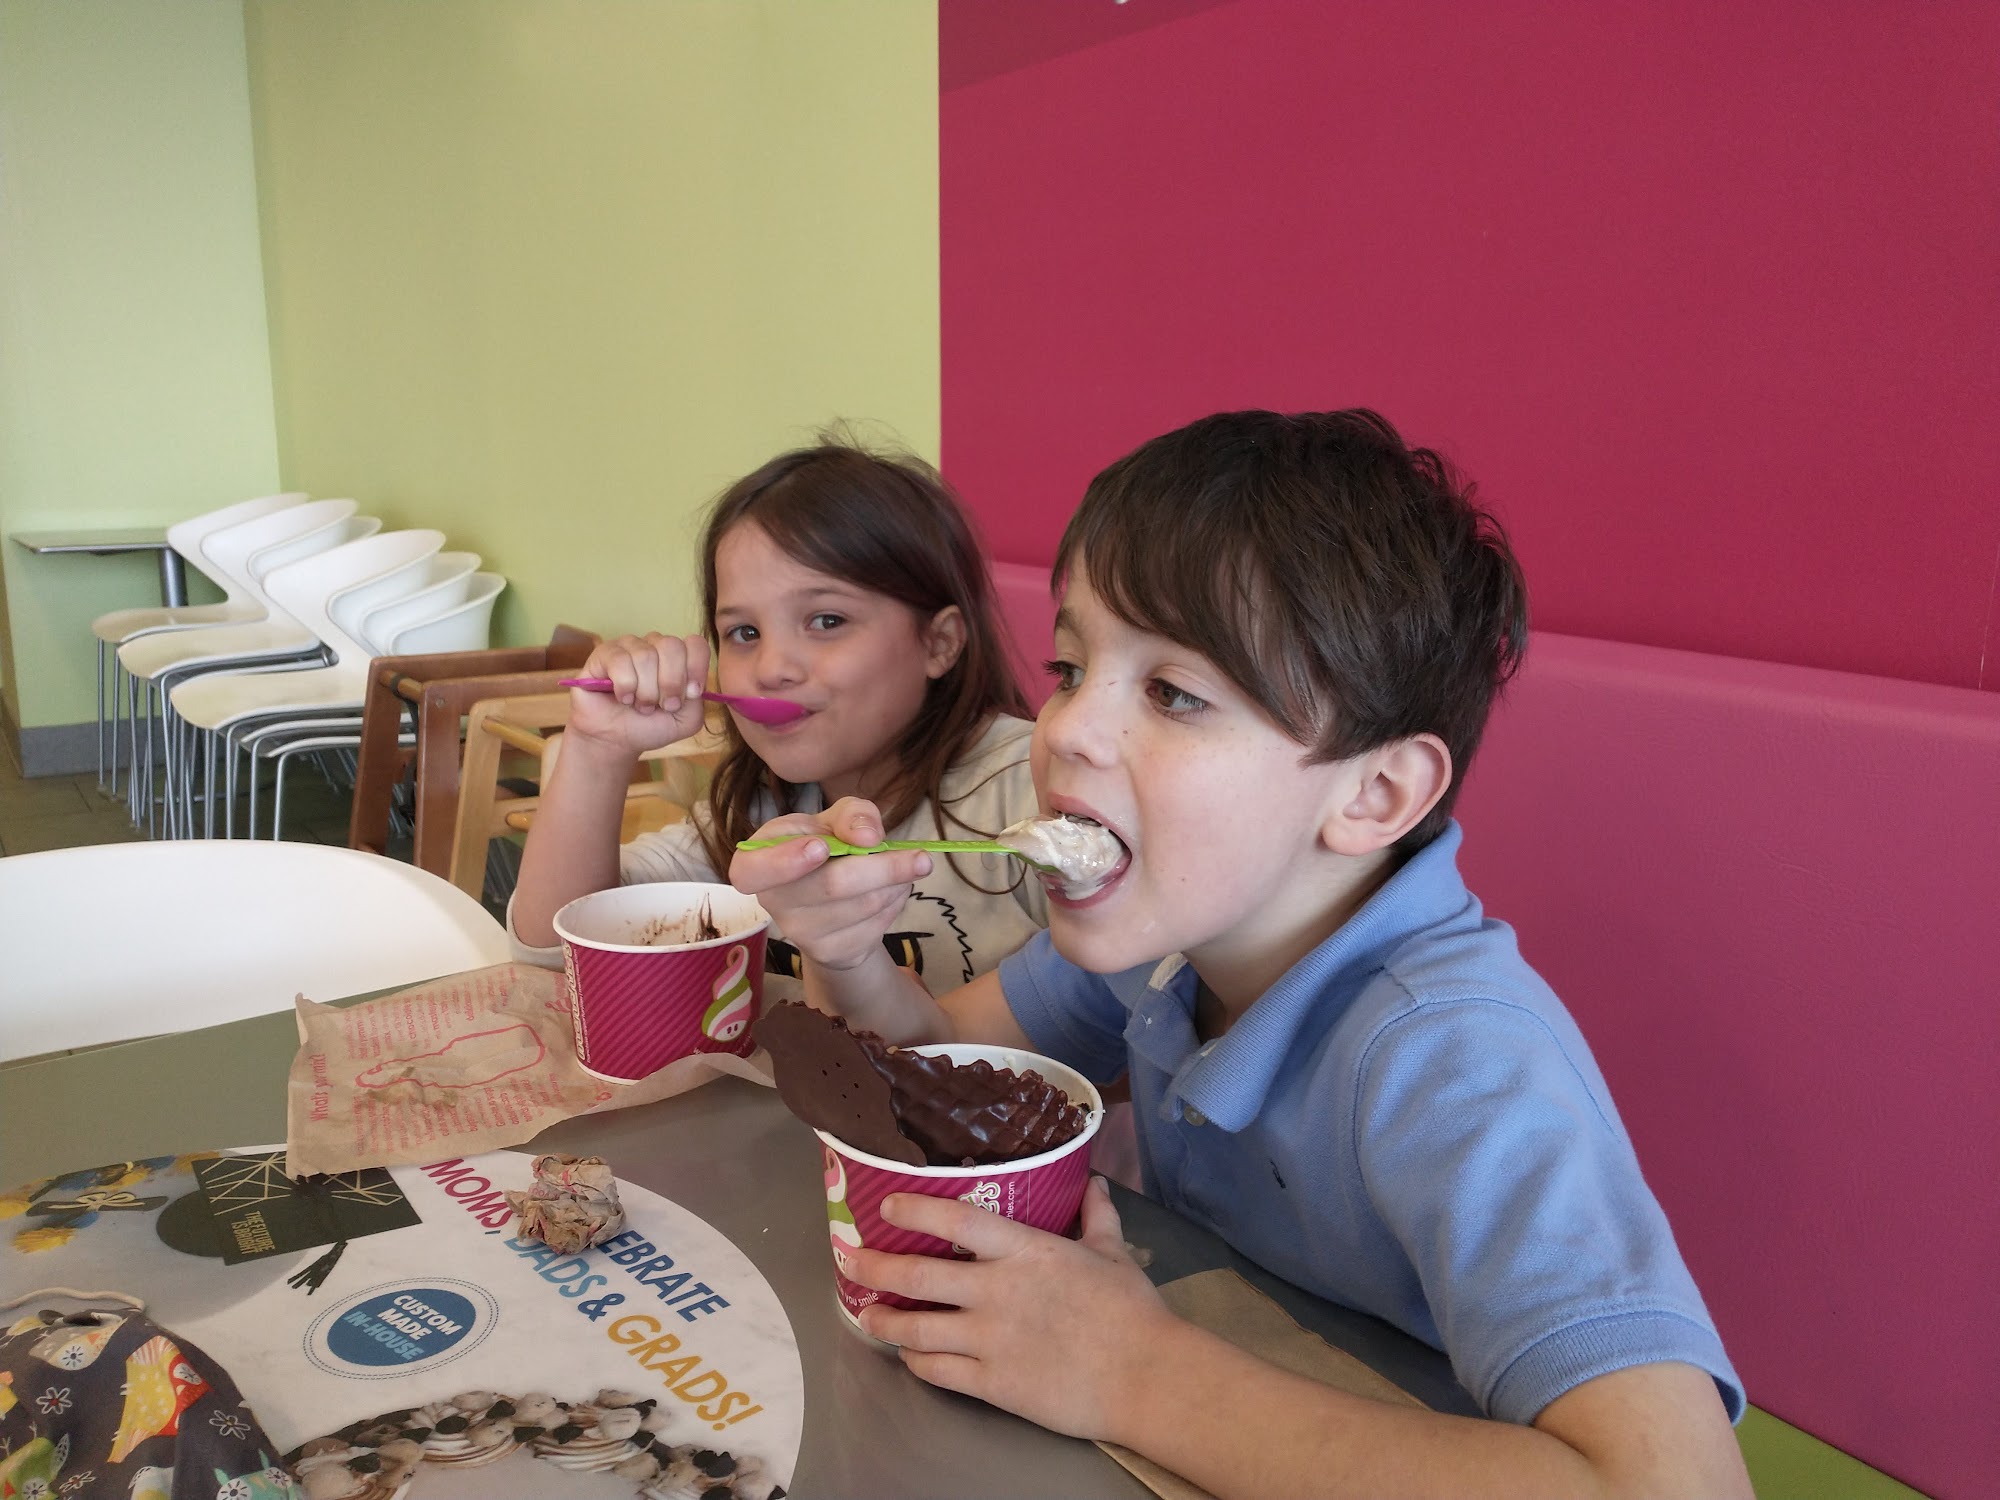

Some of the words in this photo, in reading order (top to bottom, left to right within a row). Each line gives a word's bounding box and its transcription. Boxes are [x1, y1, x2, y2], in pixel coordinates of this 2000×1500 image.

[310, 1091, 328, 1121] What's
[231, 1220, 249, 1230] IS
[244, 1210, 265, 1226] THE
[233, 1227, 259, 1255] BRIGHT
[250, 1223, 275, 1252] FUTURE
[597, 1230, 731, 1322] EBRATE
[845, 1292, 858, 1306] you
[857, 1292, 879, 1307] smile
[376, 1308, 432, 1341] MADE
[393, 1295, 463, 1336] CUSTOM
[343, 1311, 424, 1361] IN-HOUSE
[577, 1293, 625, 1322] &
[608, 1314, 764, 1431] GRADS!
